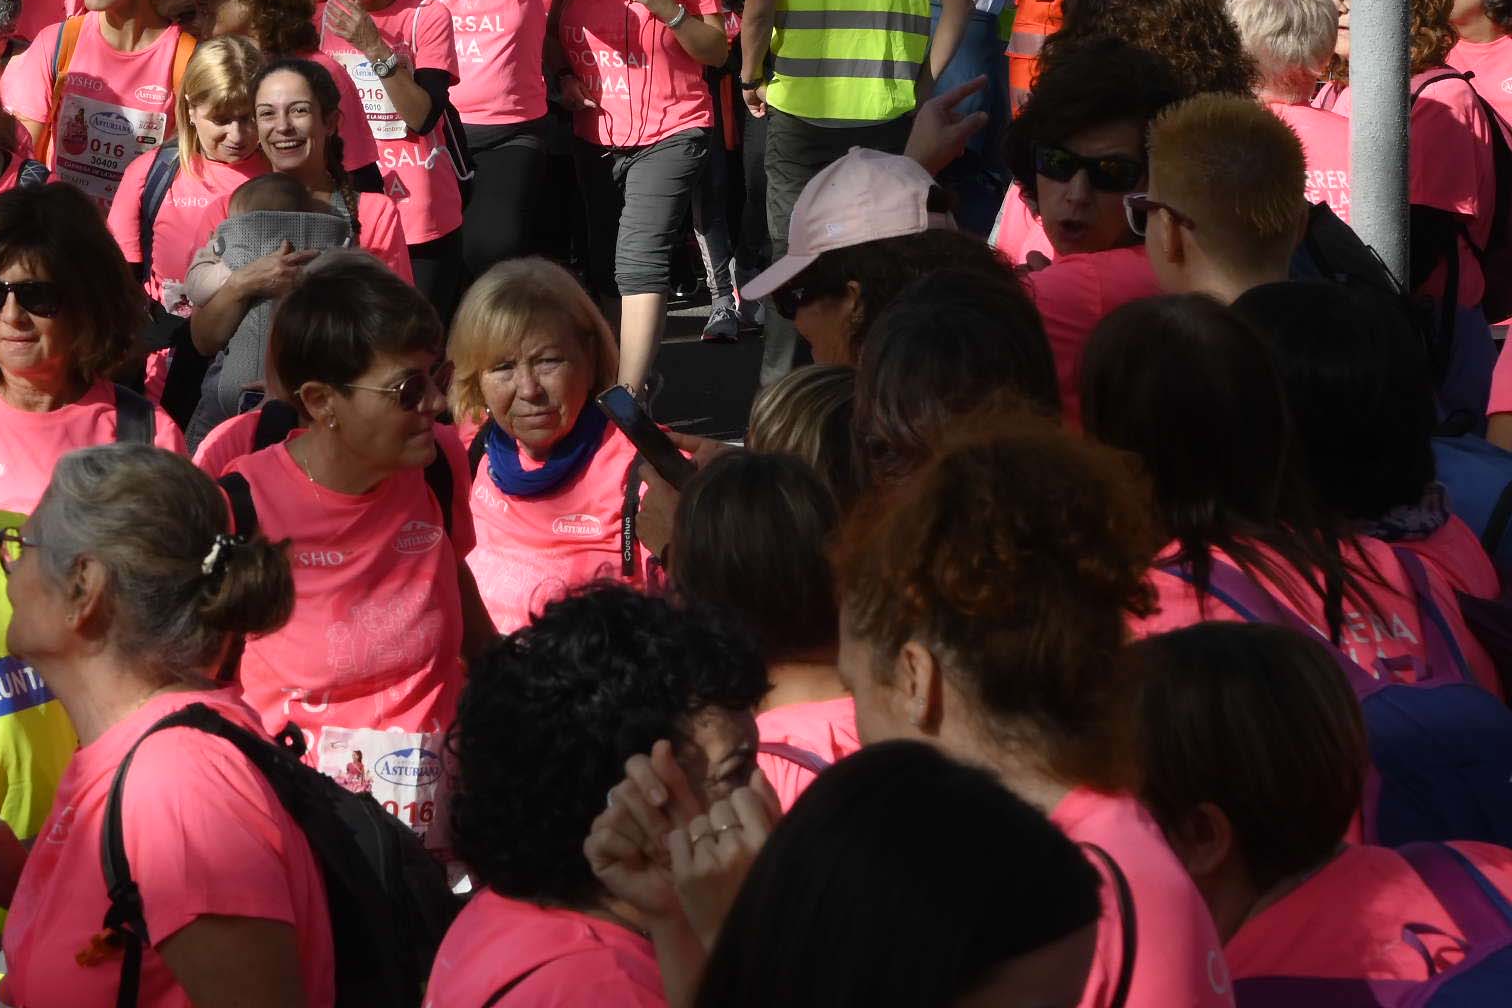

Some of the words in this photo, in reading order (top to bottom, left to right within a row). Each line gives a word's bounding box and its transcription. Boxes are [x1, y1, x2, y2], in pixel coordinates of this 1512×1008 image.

[452, 14, 505, 33] RSAL
[456, 40, 482, 57] MA
[68, 75, 104, 92] YSHO
[90, 138, 126, 156] 016
[90, 155, 119, 169] 30409
[172, 197, 208, 208] YSHO
[623, 516, 631, 562] Quechua
[299, 552, 344, 567] SHO
